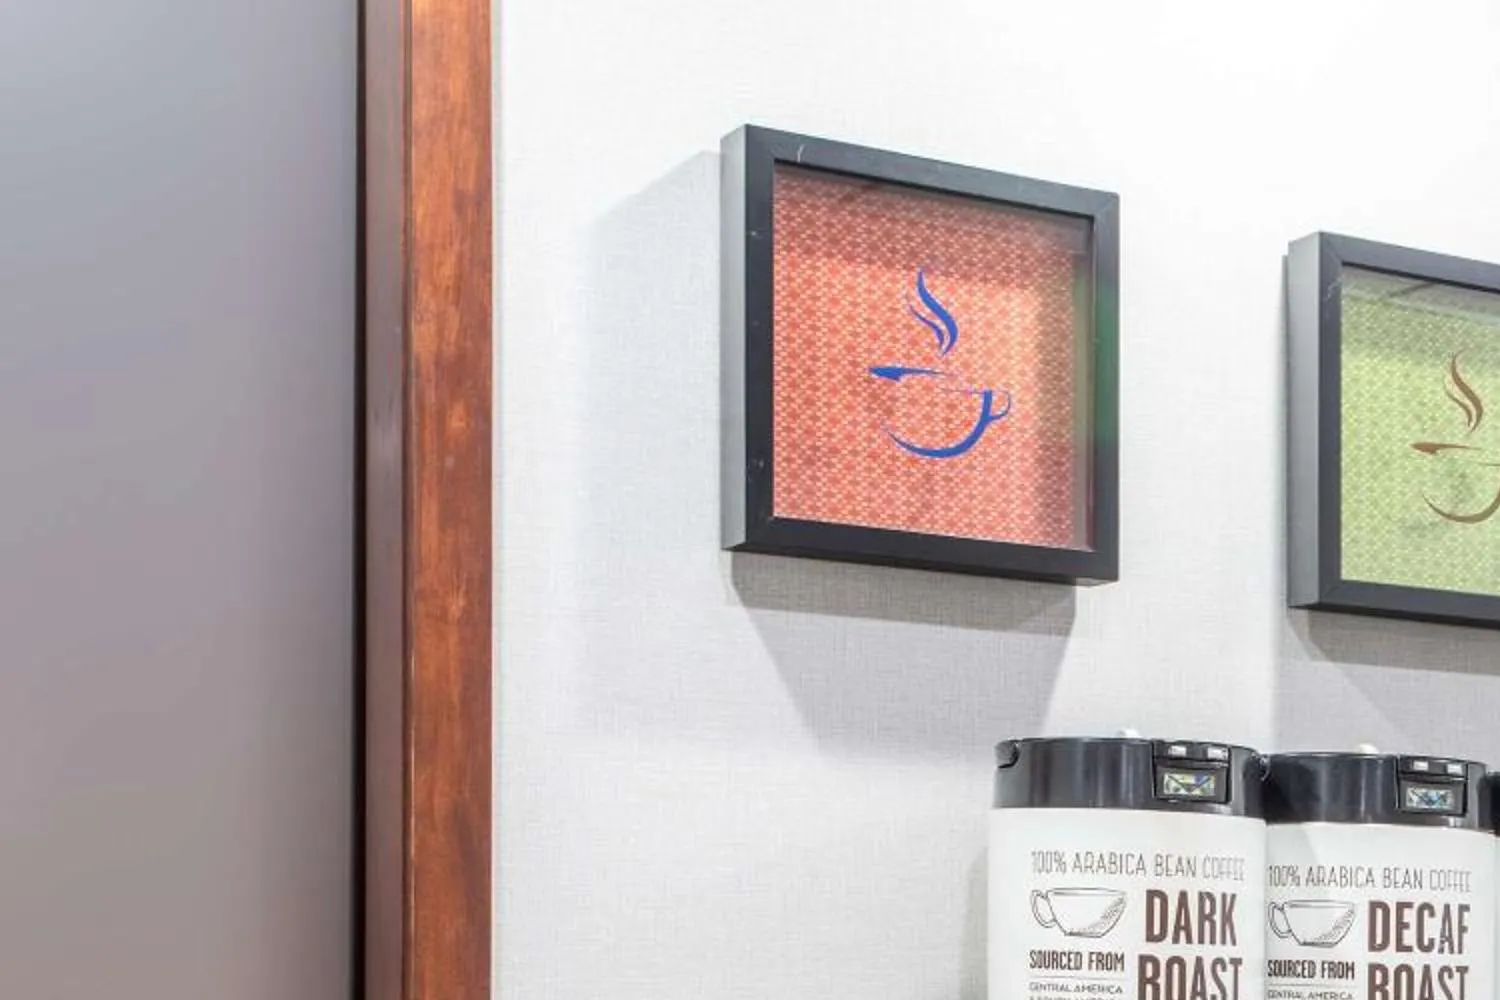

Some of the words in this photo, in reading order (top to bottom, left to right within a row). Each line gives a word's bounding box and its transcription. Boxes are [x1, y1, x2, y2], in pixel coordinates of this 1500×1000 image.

[1031, 851, 1067, 875] 100%
[1072, 852, 1147, 877] ARABICA
[1154, 854, 1197, 878] BEAN
[1202, 857, 1245, 881] COFFEE
[1268, 865, 1300, 887] 100%
[1305, 866, 1376, 889] ARABICA
[1383, 867, 1423, 890] BEAN
[1429, 869, 1472, 893] COFFEE
[1145, 889, 1237, 946] DARK
[1368, 900, 1471, 954] DECAF
[1029, 950, 1082, 970] SOURCED
[1088, 951, 1125, 972] FROM
[1267, 960, 1316, 979] SOURCED
[1321, 961, 1355, 980] FROM
[1073, 983, 1123, 995] AMERICA
[1308, 990, 1353, 1000] AMERICA
